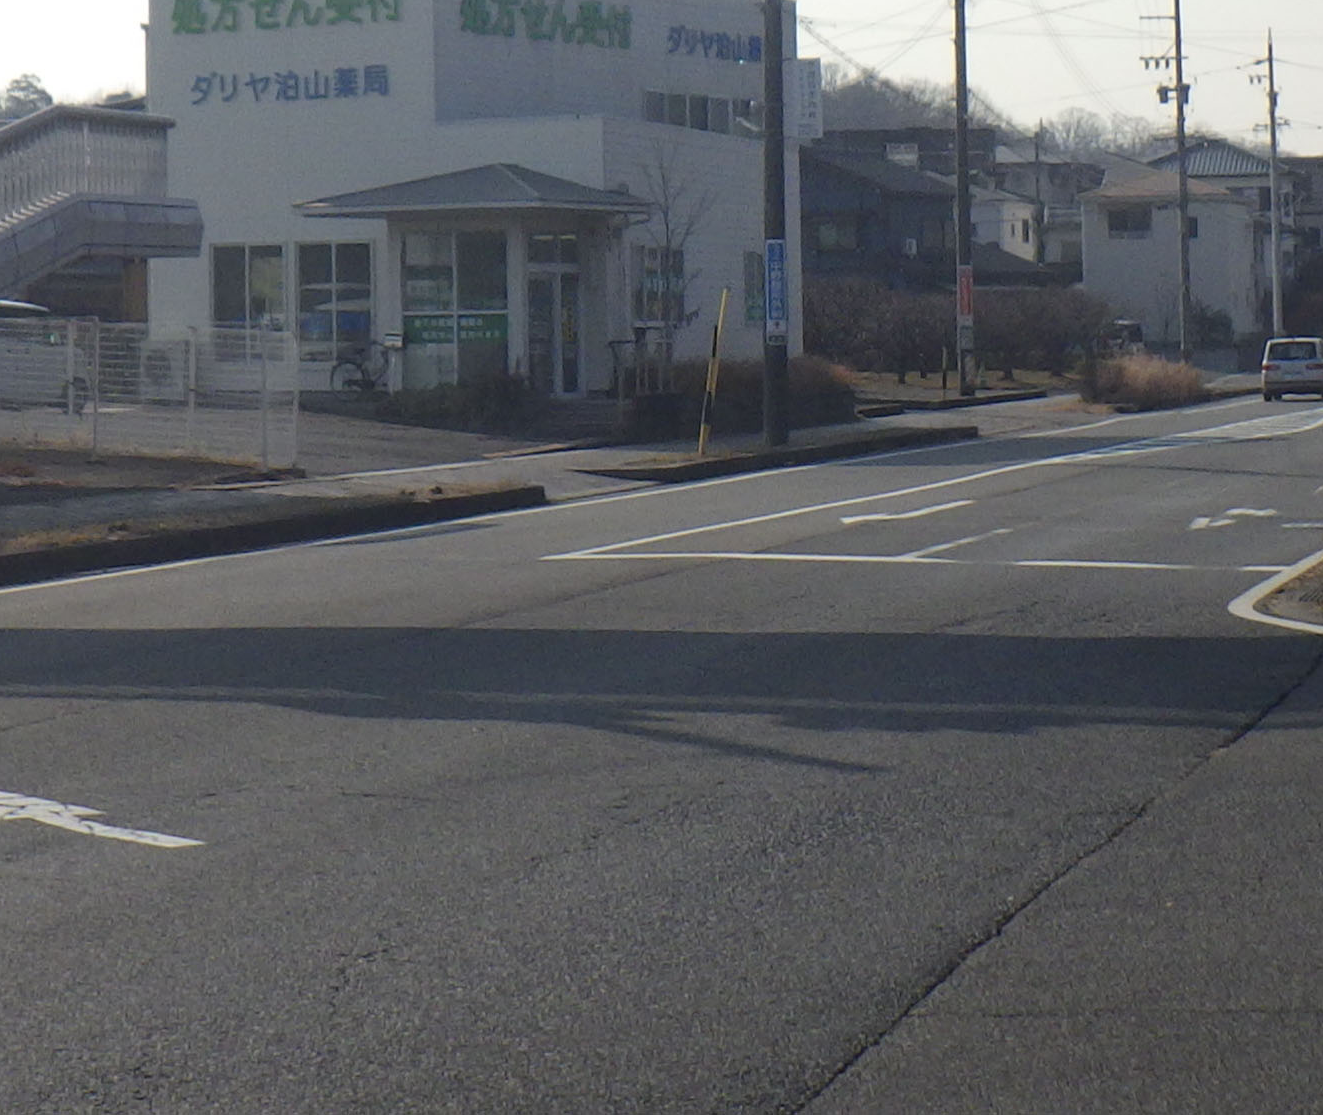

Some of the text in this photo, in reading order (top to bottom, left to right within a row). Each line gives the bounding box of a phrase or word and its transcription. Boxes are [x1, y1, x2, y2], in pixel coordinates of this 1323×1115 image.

[190, 64, 391, 106] ダリヤ泊山薬局
